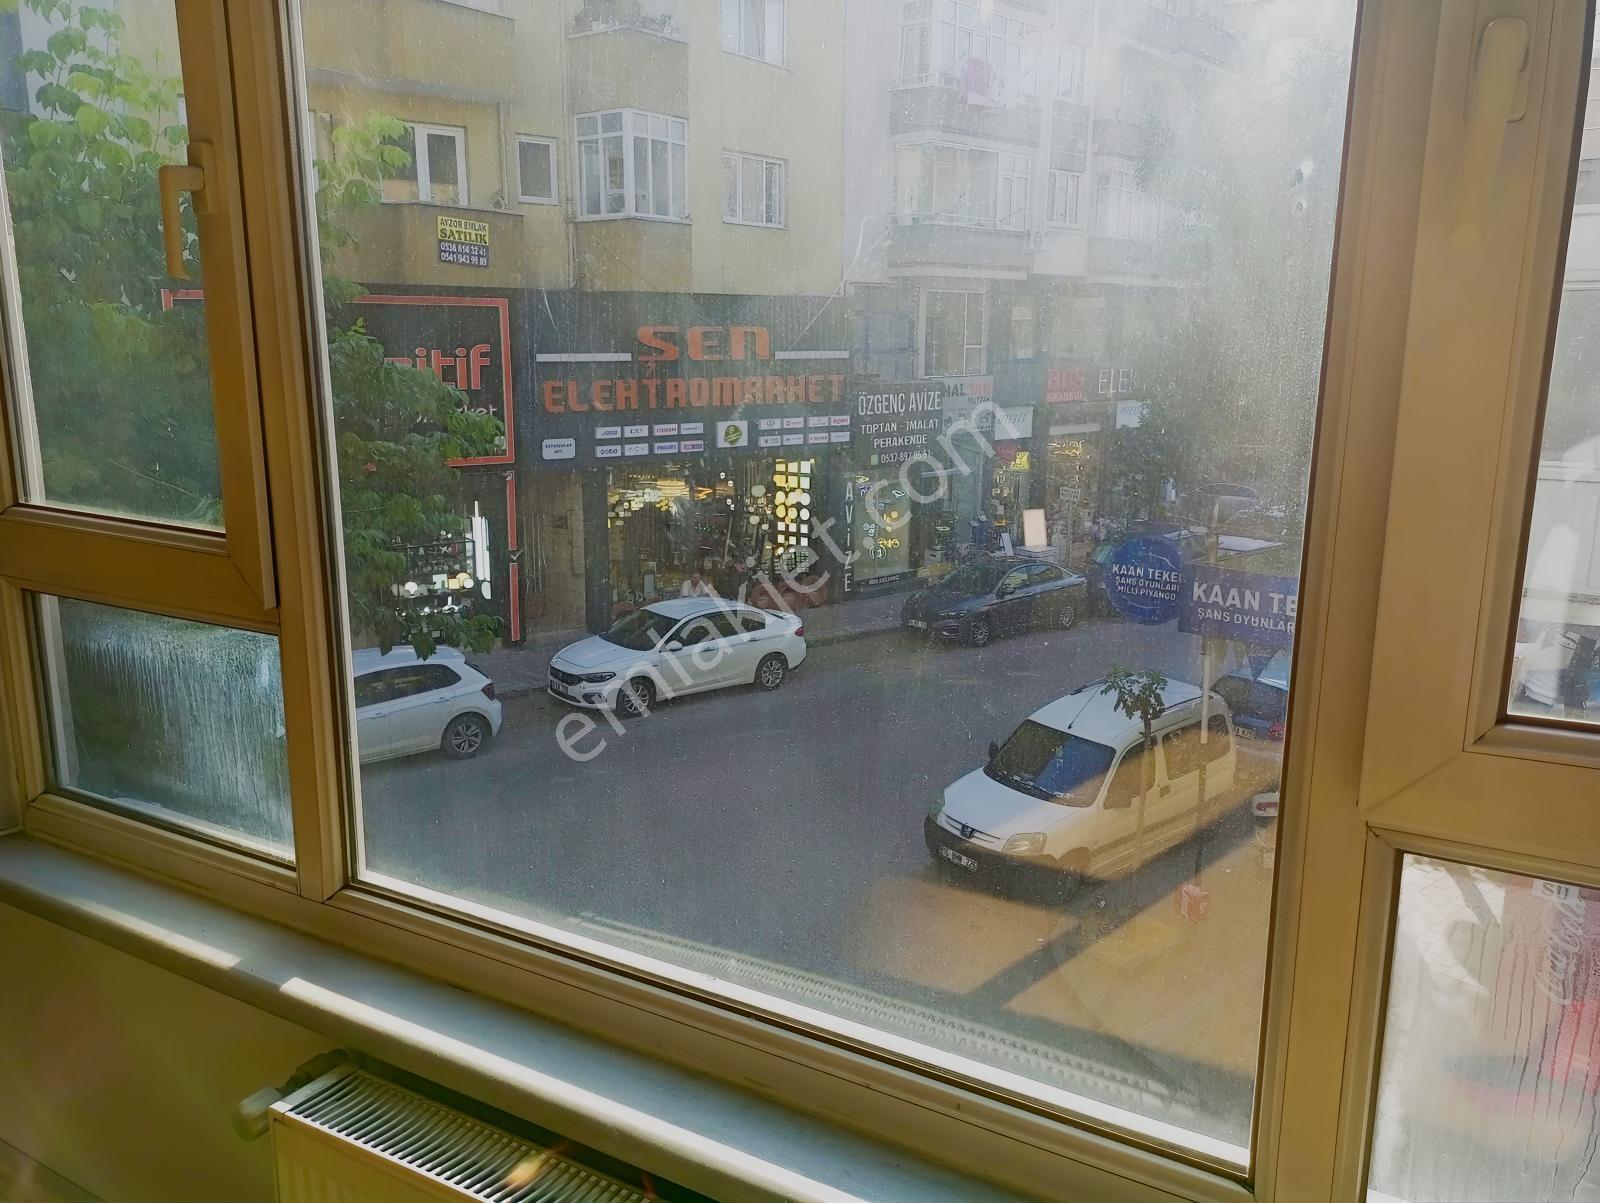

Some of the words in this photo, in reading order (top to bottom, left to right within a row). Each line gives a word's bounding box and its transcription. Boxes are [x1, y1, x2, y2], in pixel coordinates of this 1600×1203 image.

[440, 228, 488, 244] SATILIK
[637, 324, 770, 361] SEN
[858, 391, 906, 416] ÖZGENÇ
[908, 387, 942, 412] AVİZE
[861, 421, 897, 435] TOPTAN
[873, 434, 928, 449] PERAKENDE
[844, 481, 854, 592] AVİZE
[1112, 563, 1144, 577] KAAN
[1138, 579, 1180, 592] OYUNLARI
[1192, 580, 1261, 611] KAAN
